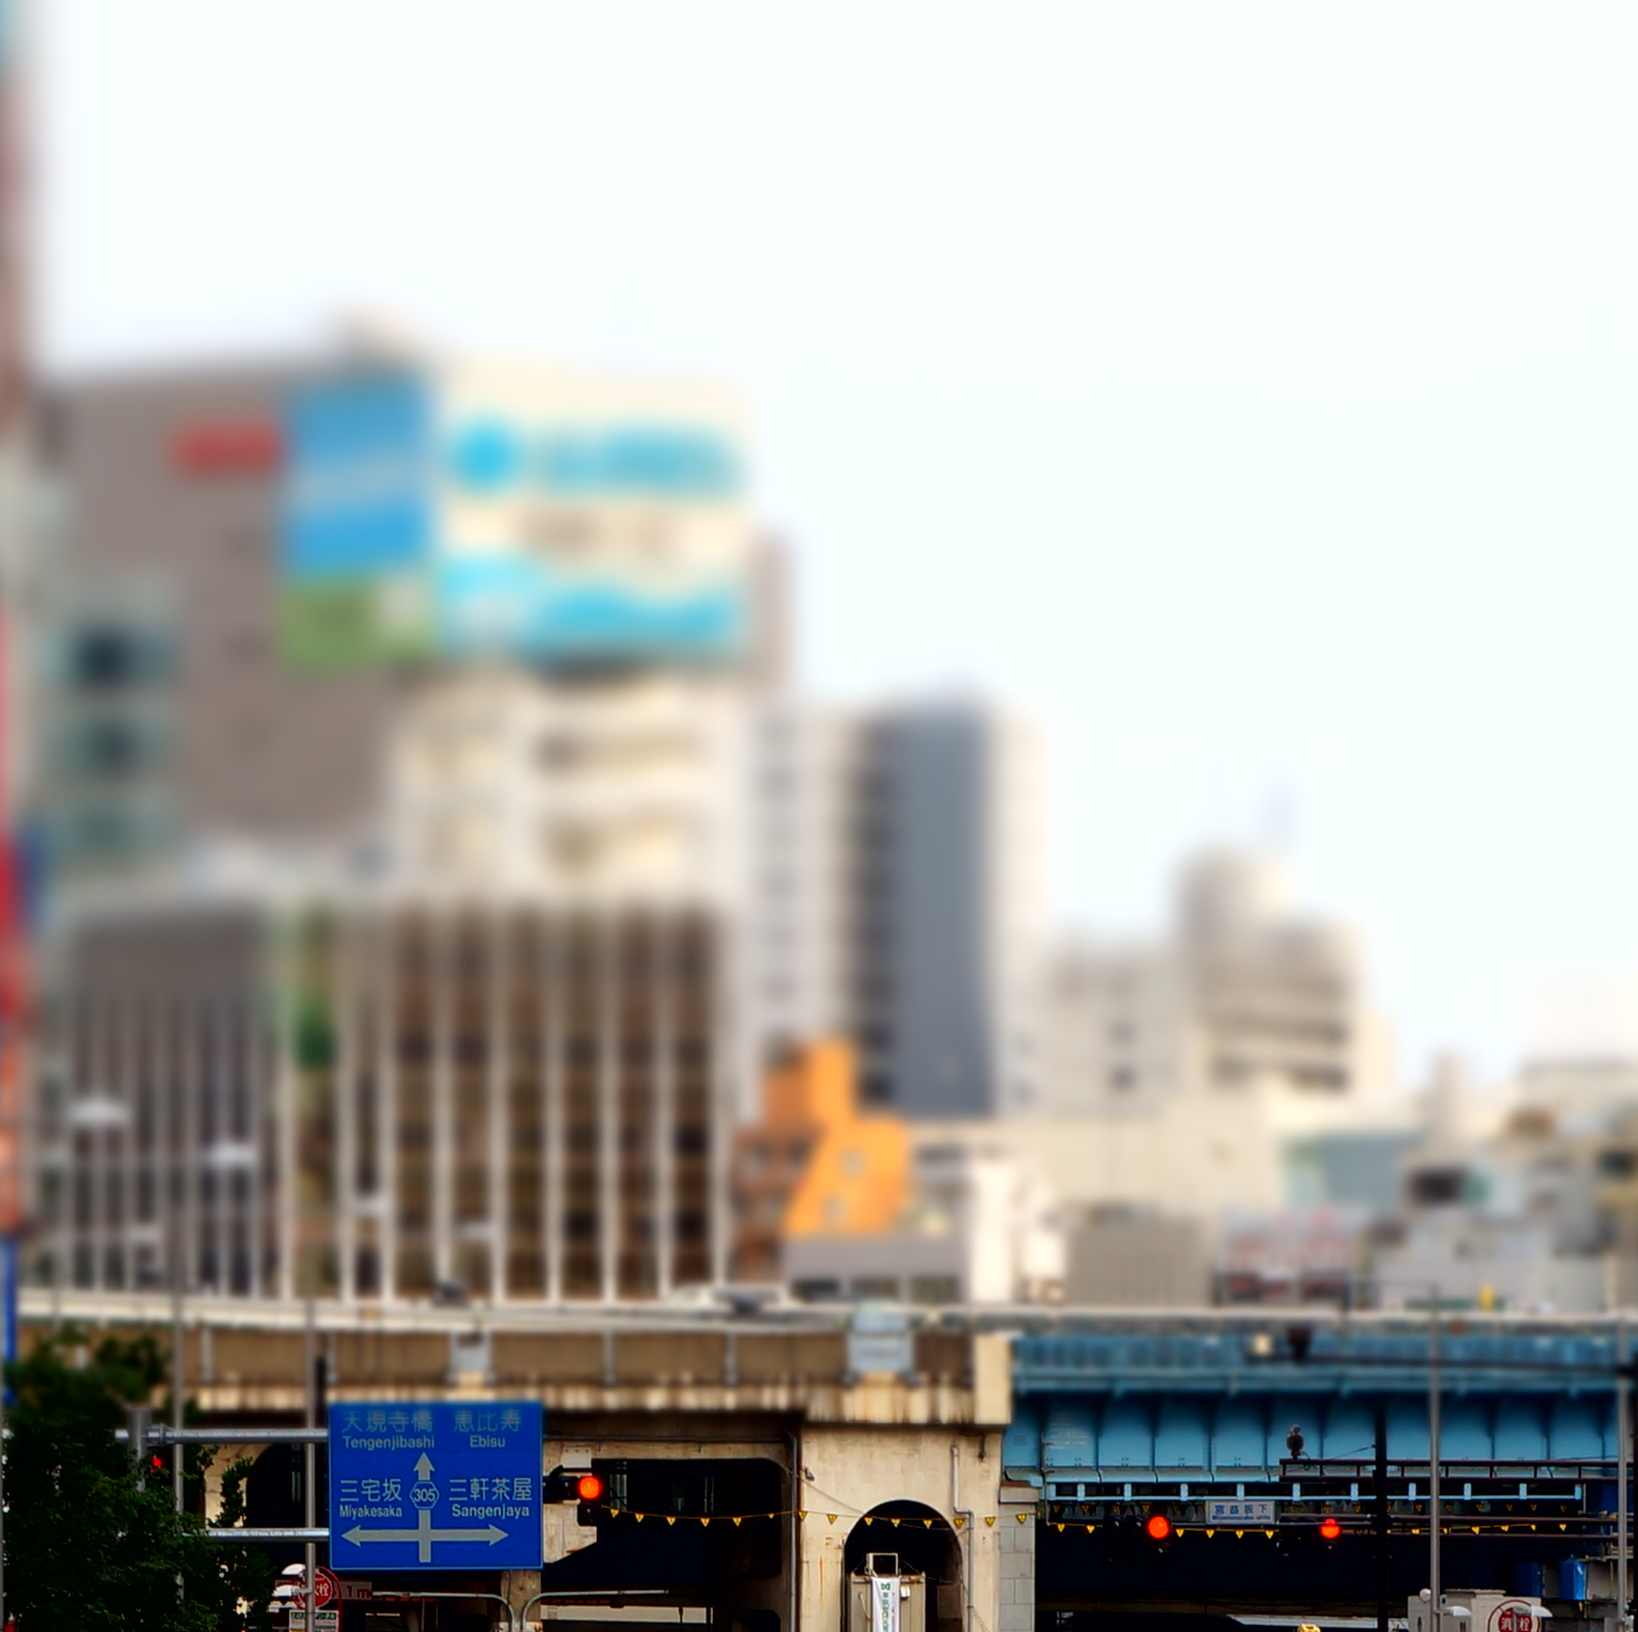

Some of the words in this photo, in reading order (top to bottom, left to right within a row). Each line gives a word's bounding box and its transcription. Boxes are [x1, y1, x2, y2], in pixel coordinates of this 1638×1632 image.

[342, 1409, 433, 1433] 天現寺橋
[453, 1409, 523, 1433] 恵比寿
[342, 1435, 435, 1451] Tengenjibashi
[469, 1435, 506, 1448] Ebisu
[340, 1478, 403, 1503] 三宅坂
[448, 1478, 533, 1502] 三軒茶屋
[413, 1488, 436, 1502] 305
[339, 1504, 403, 1520] Miyakesaka
[451, 1503, 530, 1520] Sangenjaya
[1501, 1616, 1530, 1632] 消栓
